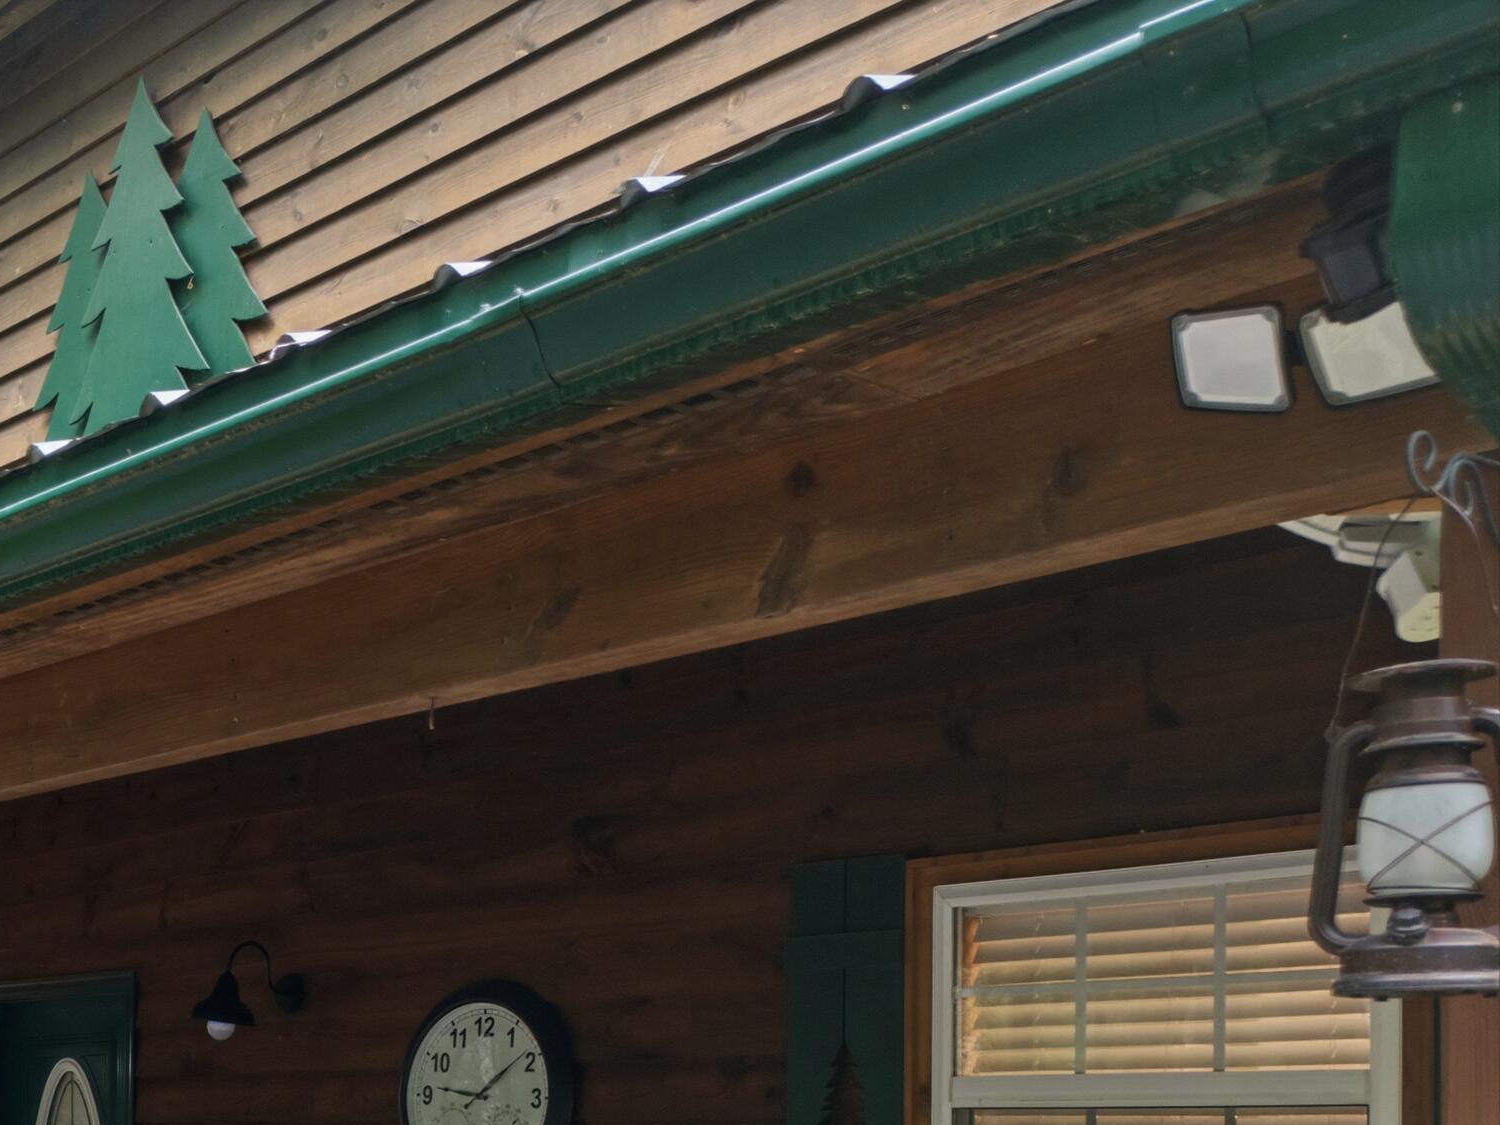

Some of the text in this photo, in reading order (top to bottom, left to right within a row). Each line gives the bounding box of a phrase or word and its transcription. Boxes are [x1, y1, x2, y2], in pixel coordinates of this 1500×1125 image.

[474, 1017, 495, 1037] 12
[450, 1028, 467, 1048] 11
[506, 1028, 515, 1048] 1
[431, 1053, 450, 1073] 10
[524, 1052, 536, 1072] 2
[422, 1085, 433, 1105] 9
[531, 1088, 542, 1109] 3
